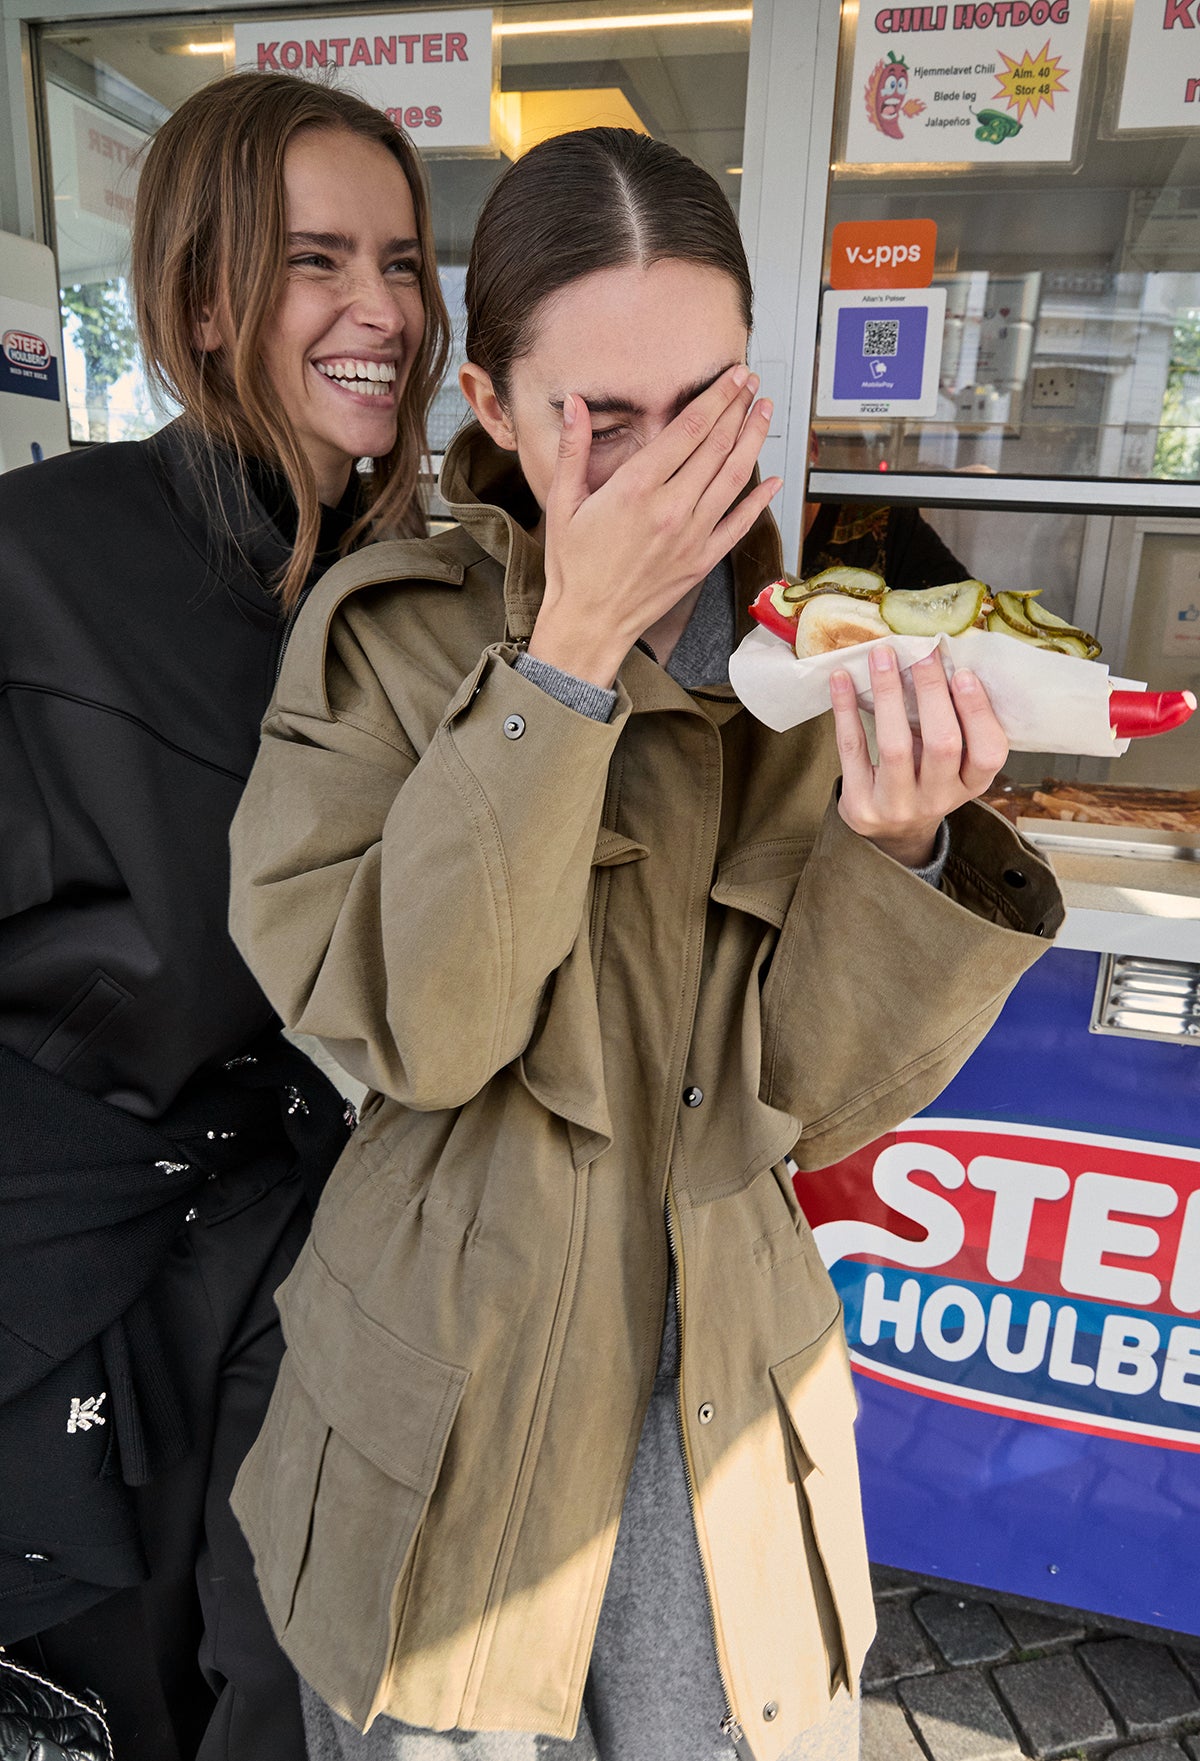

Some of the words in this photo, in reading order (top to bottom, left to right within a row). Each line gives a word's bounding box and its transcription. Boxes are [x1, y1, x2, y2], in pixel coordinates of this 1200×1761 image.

[875, 5, 948, 34] CHILI
[953, 0, 1070, 29] HOTDOG
[1162, 0, 1200, 29] K
[257, 32, 469, 71] KONTANTER
[914, 66, 972, 79] Hjemmelavet
[974, 64, 996, 74] Chili
[1012, 68, 1035, 79] Alm.
[1038, 67, 1051, 78] 40
[934, 91, 960, 101] Bløde
[962, 91, 977, 102] løg
[1015, 84, 1035, 95] Stor
[1038, 84, 1051, 95] 48
[925, 117, 971, 128] Jalapeños
[845, 244, 922, 268] vipps
[9, 333, 43, 355] STEFF
[861, 381, 894, 389] MobilePay
